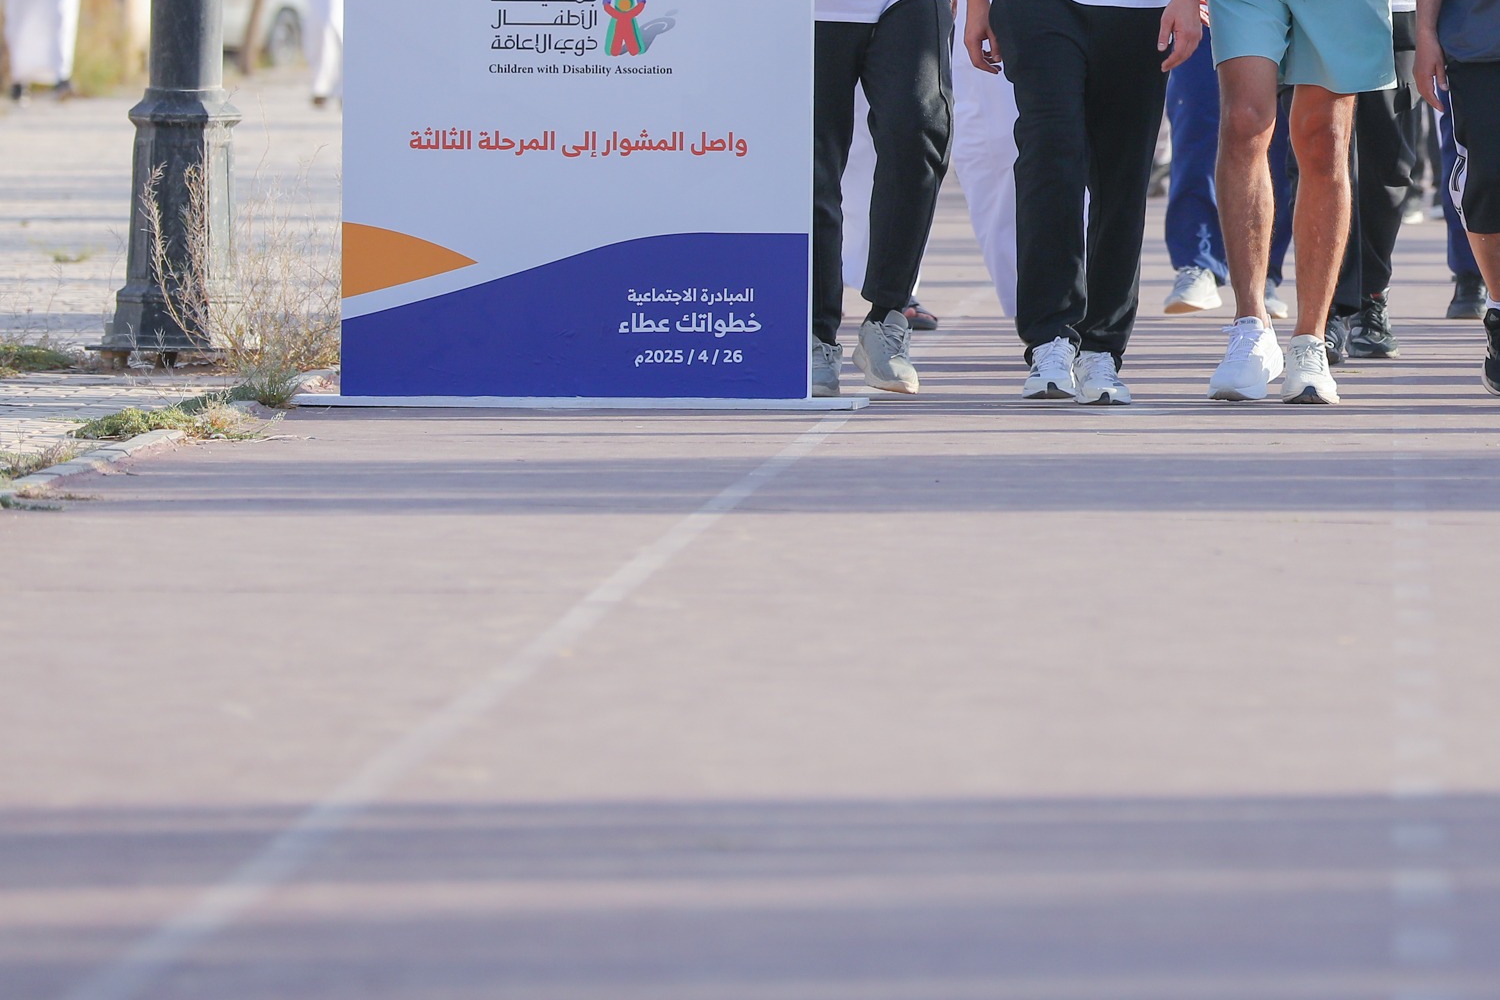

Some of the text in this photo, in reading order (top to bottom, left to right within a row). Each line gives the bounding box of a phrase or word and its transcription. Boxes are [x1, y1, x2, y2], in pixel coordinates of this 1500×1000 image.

[490, 8, 598, 30] الأطفال
[490, 34, 598, 57] ذوي الإعاقة
[488, 63, 673, 78] Children with Disability Association
[409, 126, 748, 158] واصل المشوار إلى المرحلة الثالثة
[627, 287, 755, 306] المبادرة الاجتماعية
[618, 311, 762, 339] خطواتك عطاء
[697, 349, 709, 364] 4
[723, 349, 744, 364] 26
